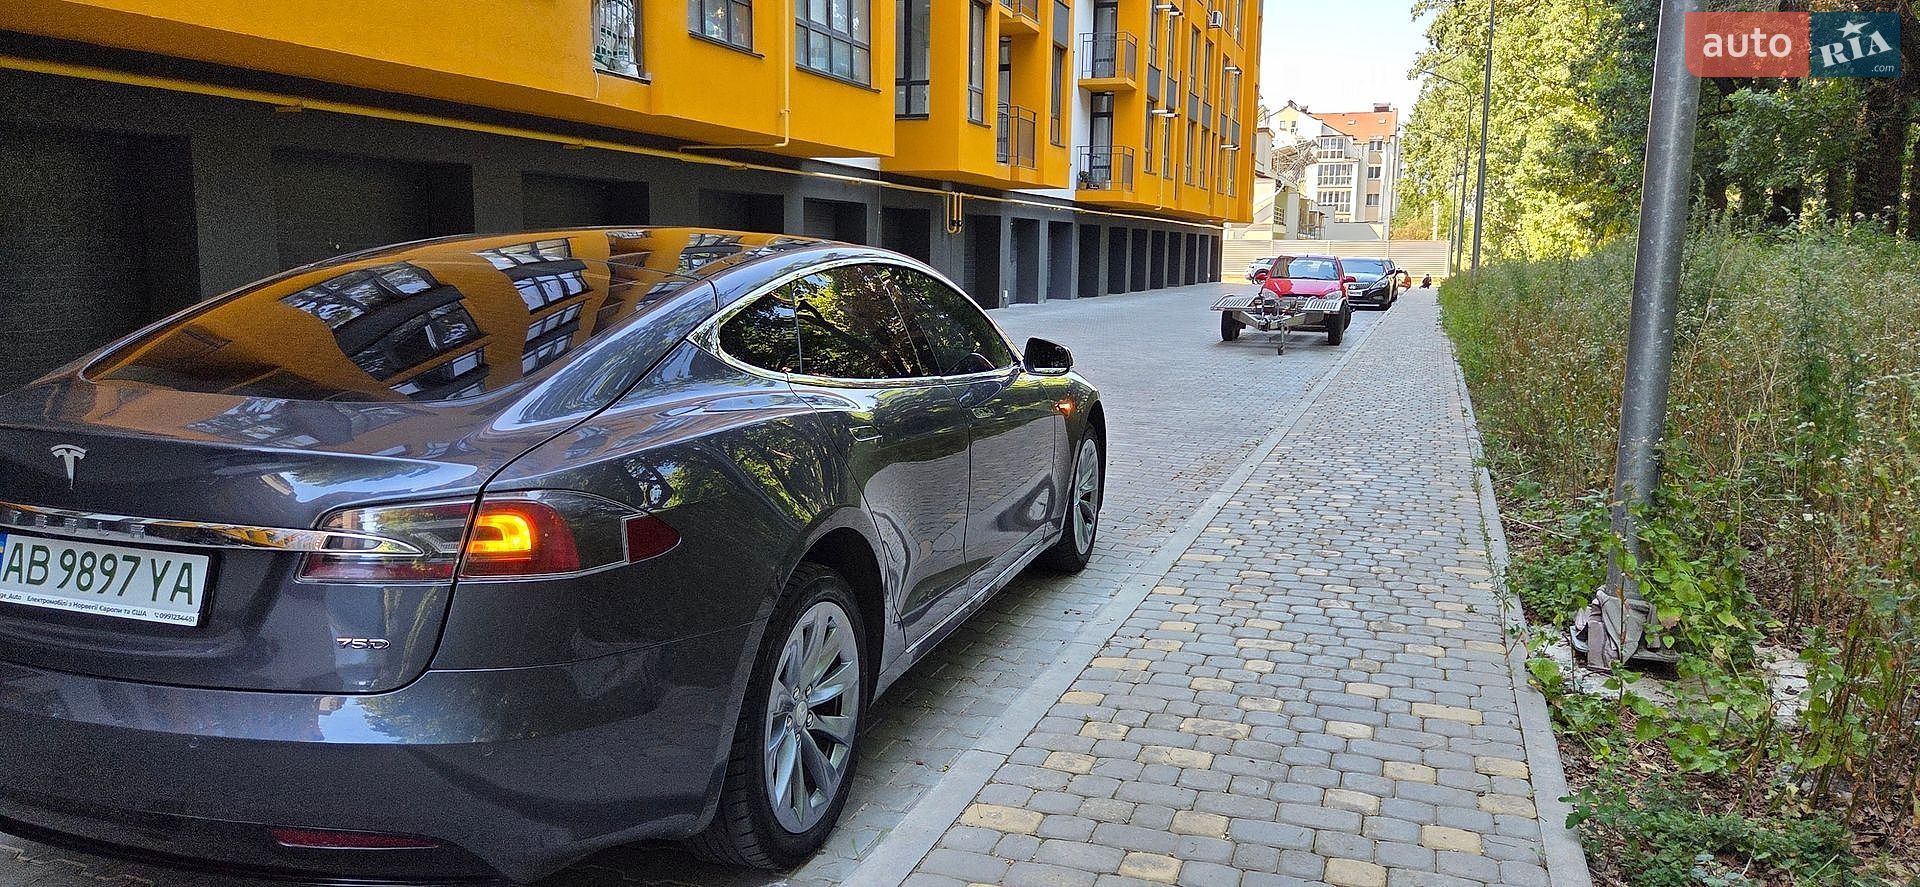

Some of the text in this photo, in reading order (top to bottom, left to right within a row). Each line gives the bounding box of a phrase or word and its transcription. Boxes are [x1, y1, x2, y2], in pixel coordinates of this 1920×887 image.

[2, 542, 193, 605] AB 9897 YA
[131, 609, 147, 617] США
[336, 637, 391, 650] 75D
